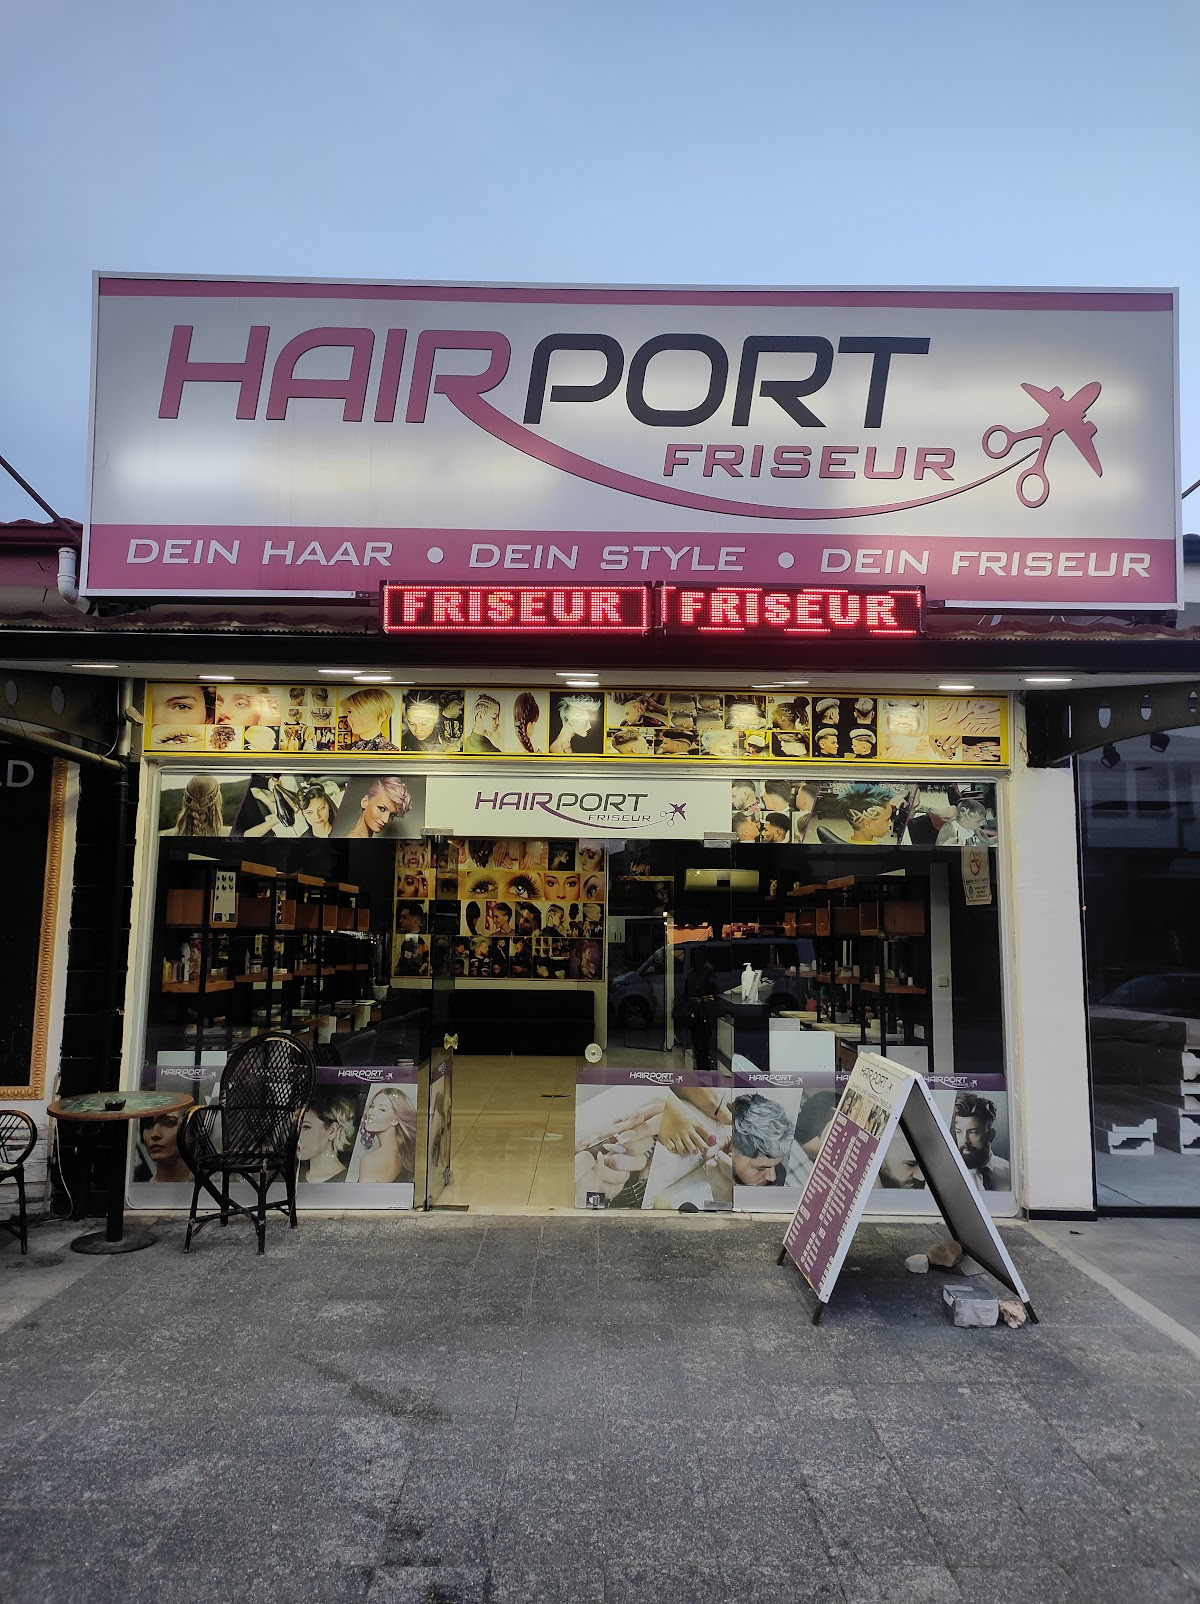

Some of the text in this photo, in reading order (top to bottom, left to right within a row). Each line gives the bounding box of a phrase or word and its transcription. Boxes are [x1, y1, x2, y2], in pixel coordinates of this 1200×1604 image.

[158, 324, 931, 429] HAIRPORT
[663, 443, 956, 481] FRISEUR
[126, 538, 1152, 578] DEIN HAAR DEIN STYLE DEIN FRISEUR
[403, 590, 899, 628] FRISEUR FRISEUR
[474, 791, 649, 812] HAIRPORT
[588, 814, 651, 822] FRISEUR
[160, 1068, 207, 1076] HAIRPORT
[337, 1069, 384, 1077] HAIRPORT
[629, 1071, 674, 1079] HAIRPORT
